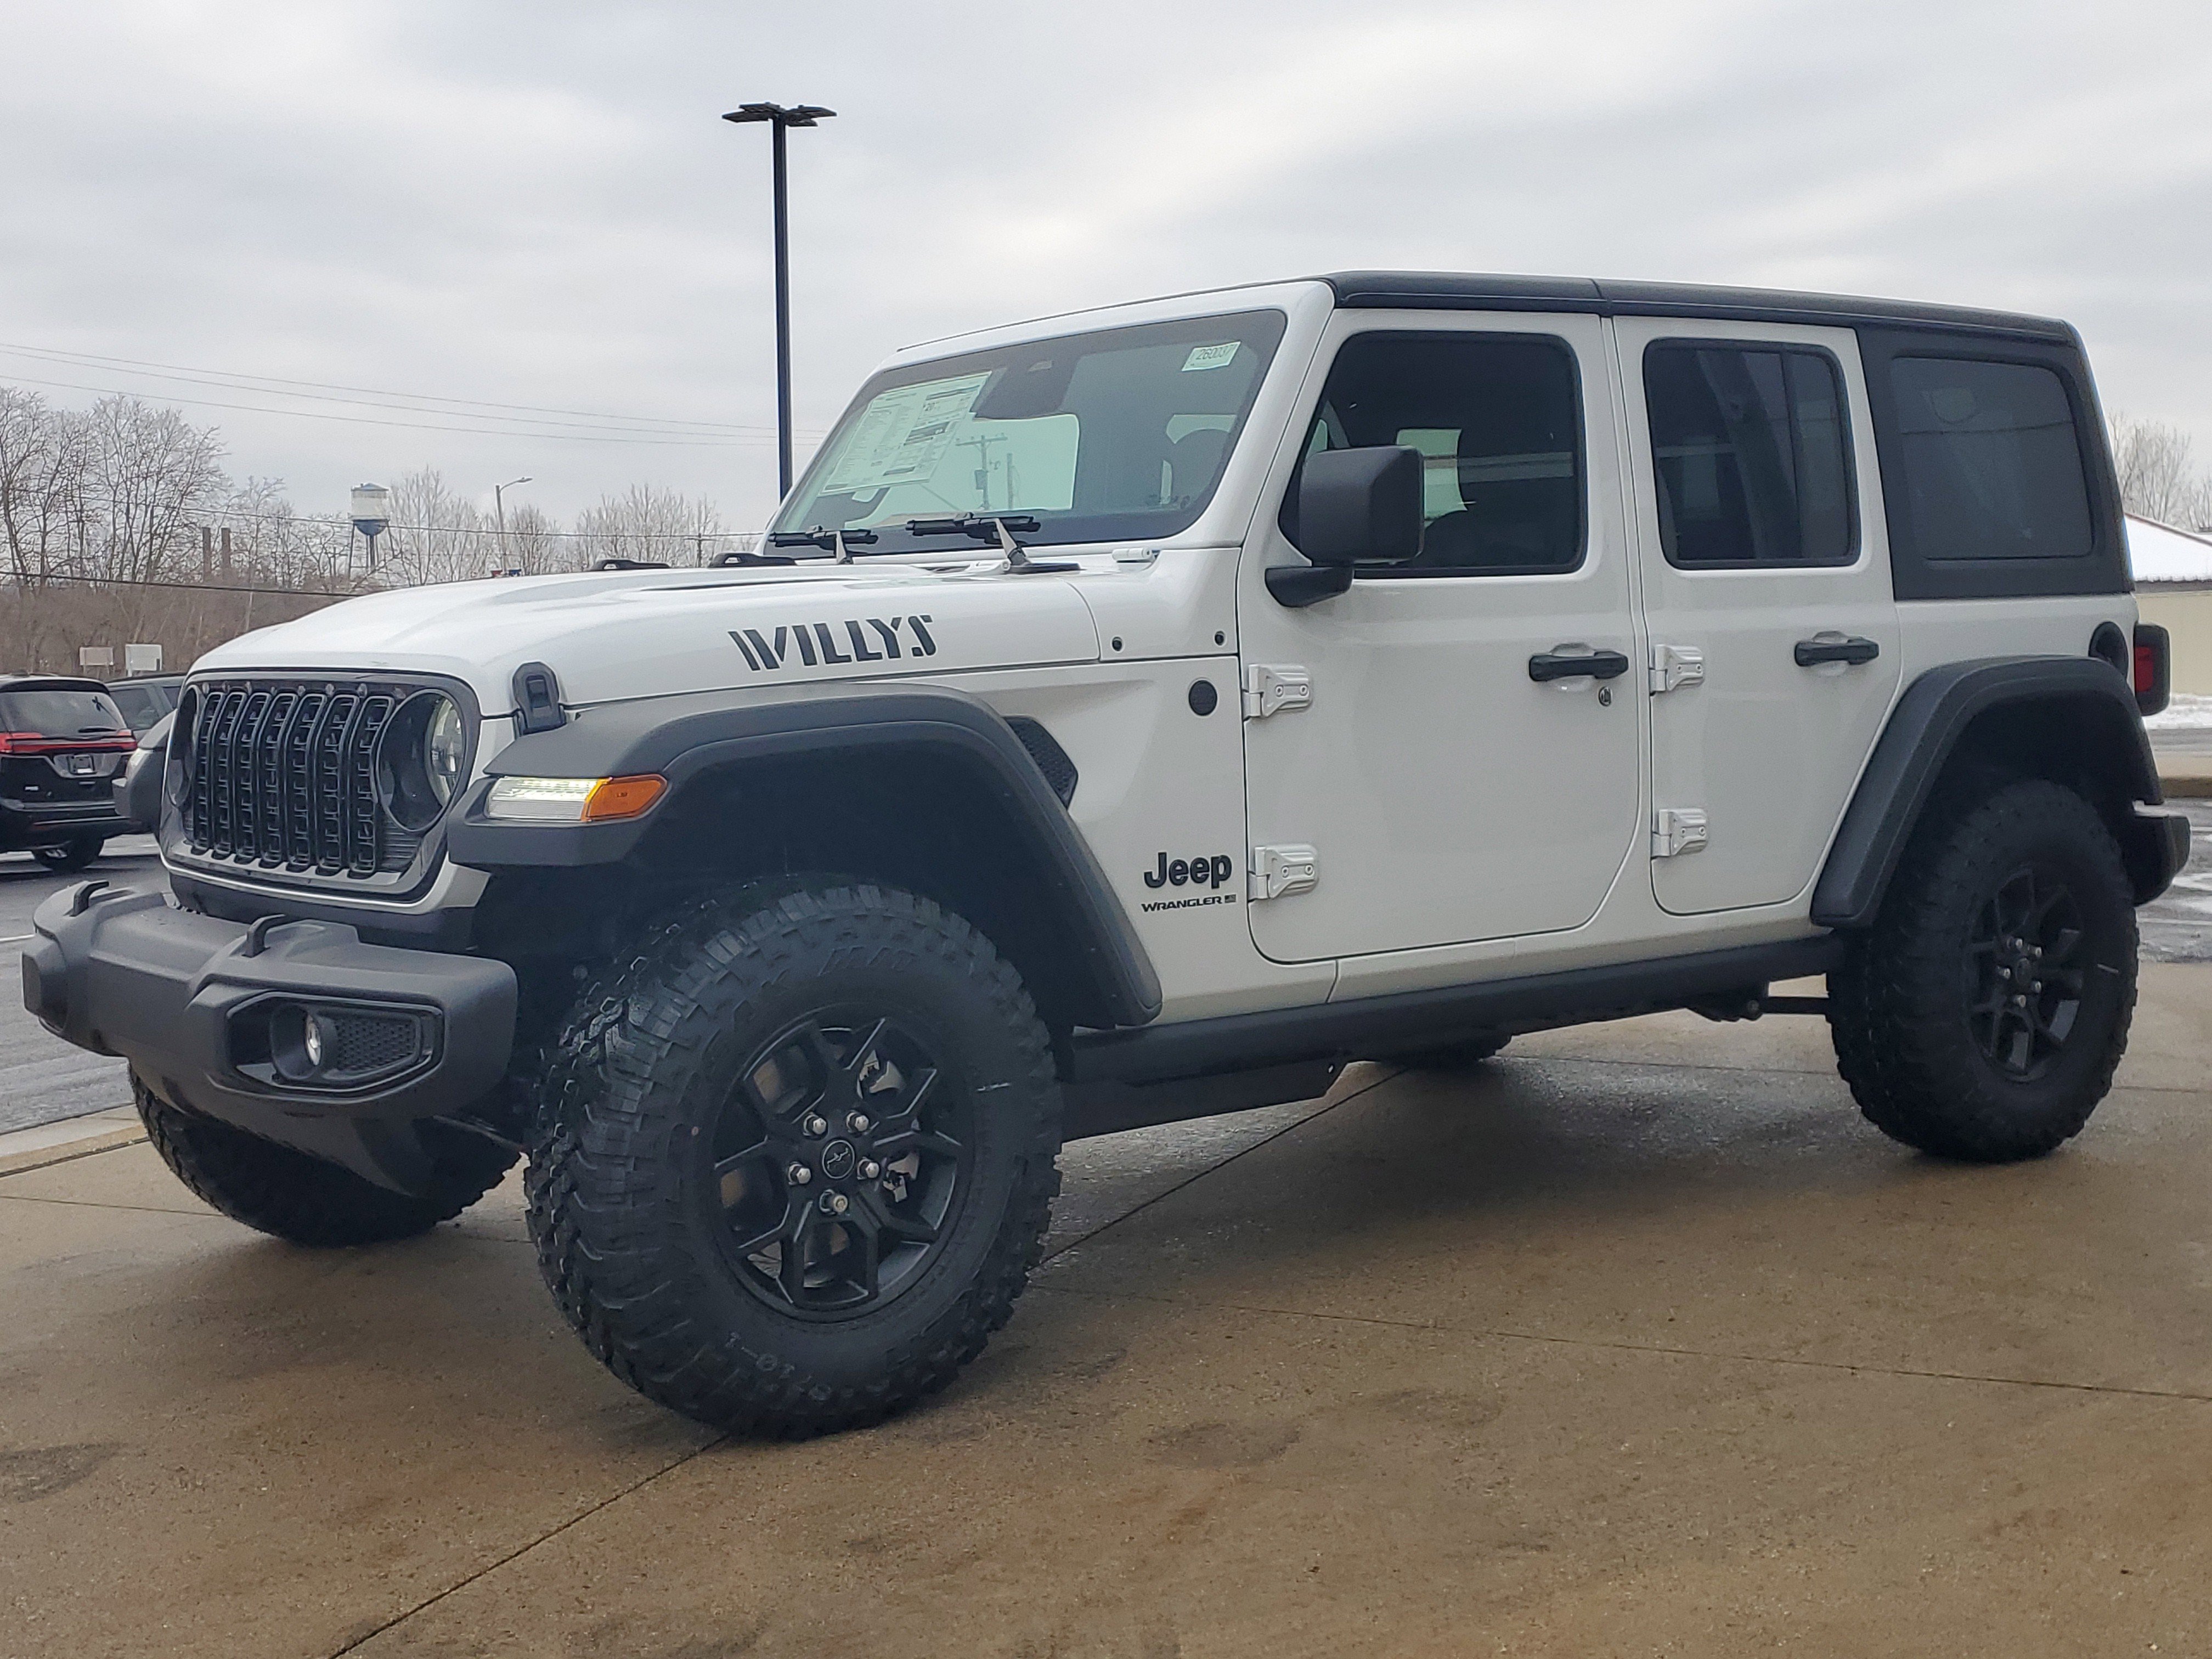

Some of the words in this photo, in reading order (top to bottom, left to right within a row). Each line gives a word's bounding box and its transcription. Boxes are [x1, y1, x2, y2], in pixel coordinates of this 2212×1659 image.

[727, 614, 936, 671] WILLYS
[1144, 852, 1232, 889] Jeep
[1141, 896, 1222, 912] WRANGLER
